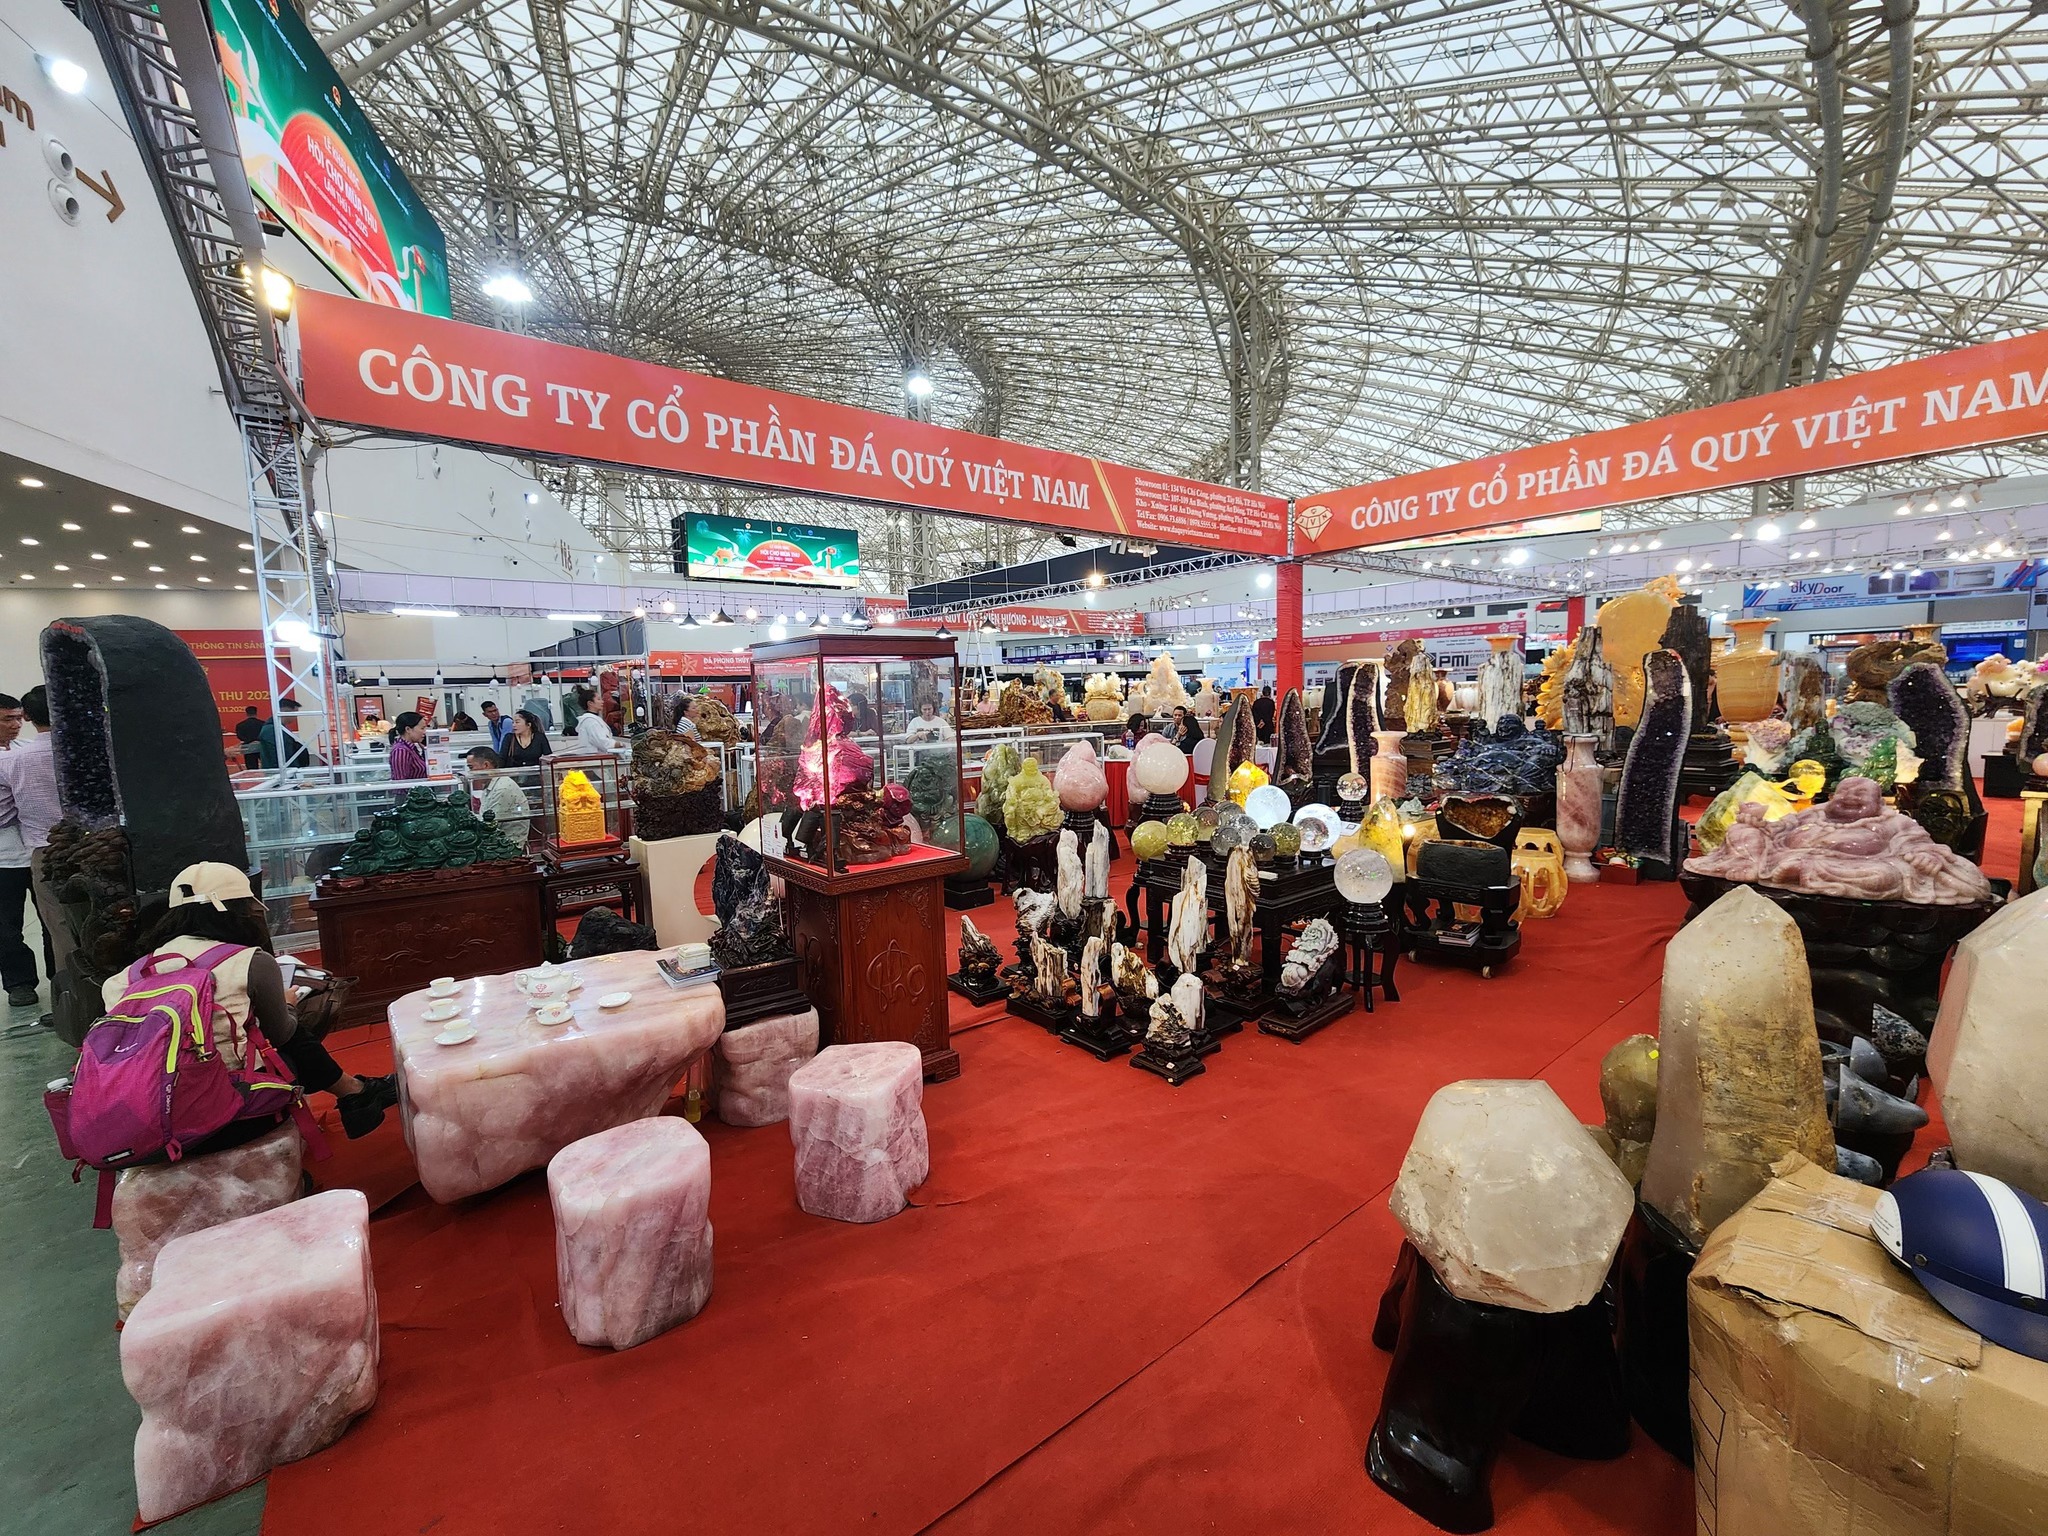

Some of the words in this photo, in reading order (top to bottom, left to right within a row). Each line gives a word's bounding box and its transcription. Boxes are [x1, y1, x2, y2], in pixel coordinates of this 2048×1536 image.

[358, 344, 531, 417] CÔNG
[546, 382, 611, 431] TY
[626, 384, 690, 444] CỔ
[702, 403, 817, 466] PHẦN
[829, 431, 883, 477] ĐÁ
[890, 447, 955, 489] QUÝ
[961, 459, 1025, 504] VIỆT
[1032, 473, 1091, 510] NAM
[1350, 497, 1419, 530] CÔNG
[1426, 486, 1461, 515] TY
[1468, 463, 1508, 508] CỔ
[1517, 447, 1611, 500] PHẦN
[1622, 433, 1679, 481] ĐÁ
[1691, 412, 1780, 472] QUÝ
[1792, 395, 1906, 449] VIỆT
[1921, 371, 2048, 428] NAM
[1135, 477, 1162, 489] Showroom
[1135, 487, 1162, 500] Showroom
[1136, 498, 1147, 507] Kho
[1136, 520, 1159, 530] Website:
[190, 641, 225, 650] THÔNG
[1439, 654, 1469, 667] PMI
[218, 691, 243, 701] THU
